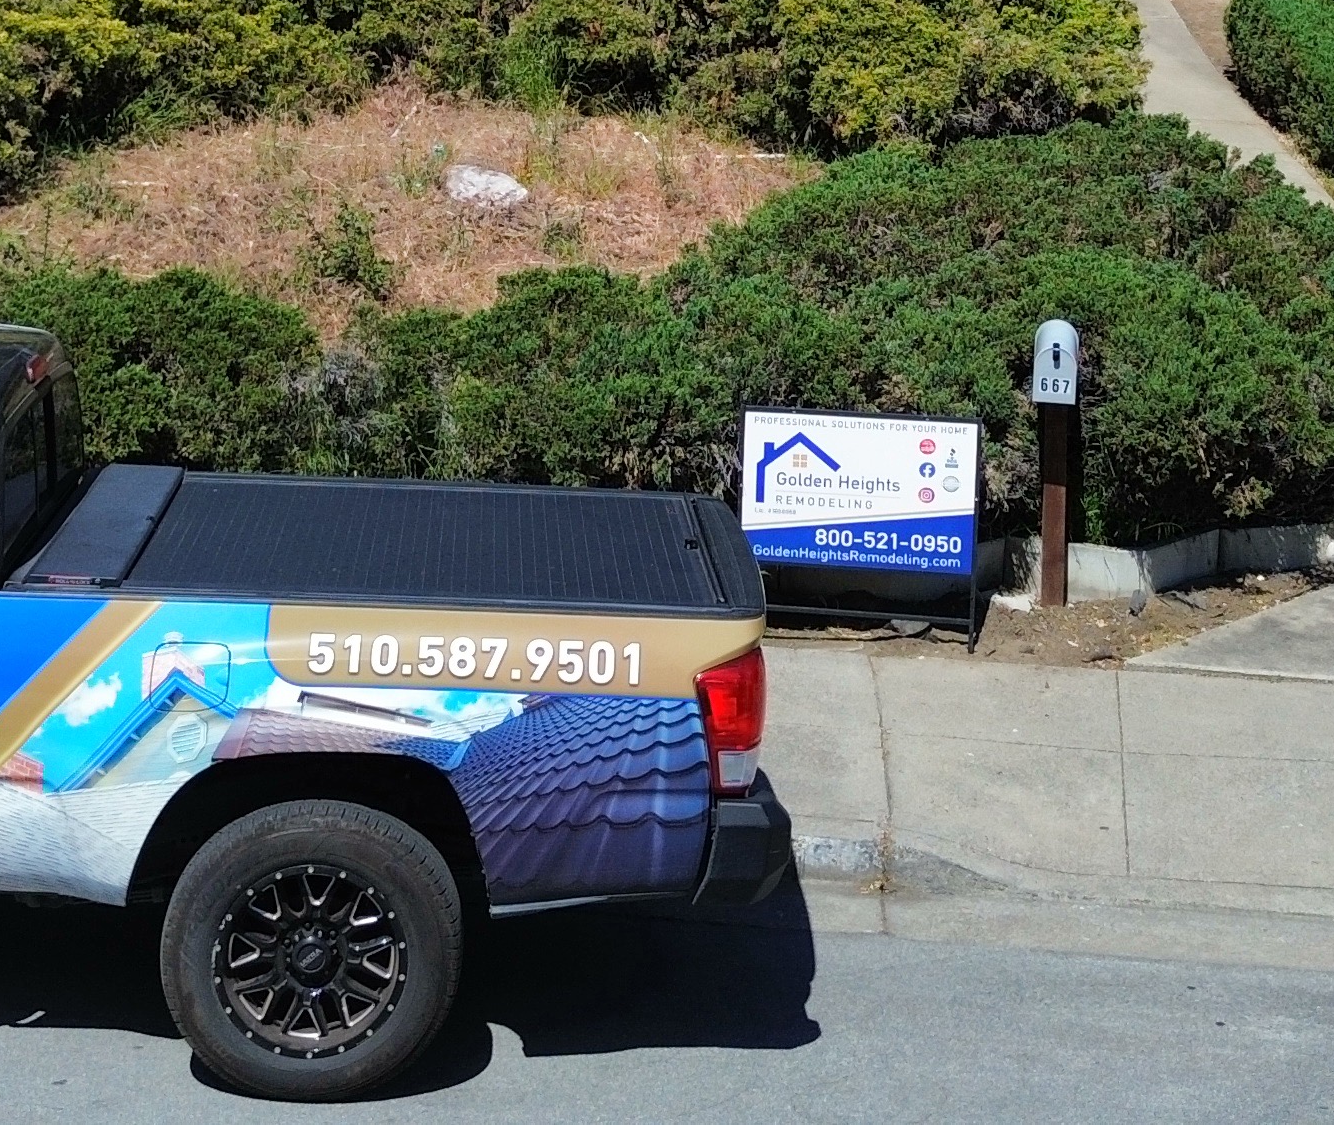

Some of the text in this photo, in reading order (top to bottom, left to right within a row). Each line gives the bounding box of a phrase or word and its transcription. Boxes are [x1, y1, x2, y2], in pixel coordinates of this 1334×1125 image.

[1040, 377, 1071, 394] 667
[753, 415, 968, 435] PROFESSIONAL SOLUTIONS FOR YOUR HOME
[776, 471, 901, 495] Golden Heights
[775, 495, 874, 510] REMODELING
[814, 528, 962, 554] 800-521-0950
[752, 543, 961, 569] GoldenHeightsRemodeling.com
[307, 632, 642, 687] 510.587.9501
